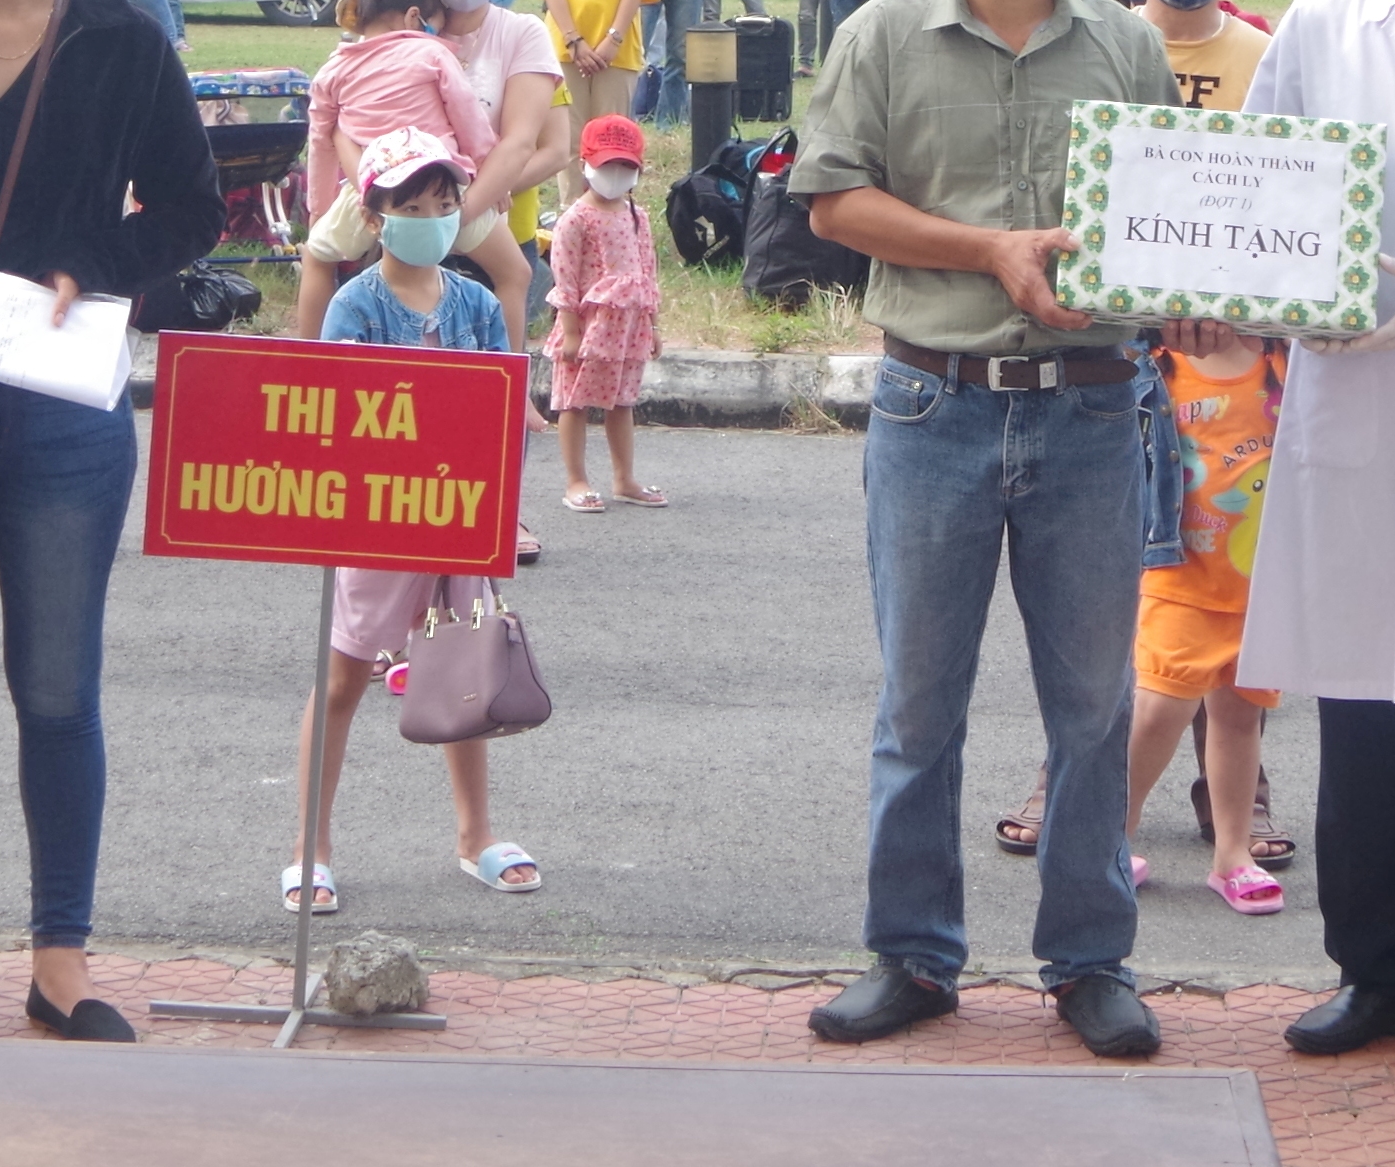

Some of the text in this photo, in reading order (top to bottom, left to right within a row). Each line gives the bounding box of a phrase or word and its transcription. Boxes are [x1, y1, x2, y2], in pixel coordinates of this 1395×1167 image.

[1169, 149, 1203, 164] CON
[1242, 174, 1264, 189] LY
[1241, 197, 1253, 211] 1)
[1124, 213, 1322, 259] KÍNH TẶNG
[261, 381, 417, 447] THỊ XÃ
[1171, 394, 1230, 424] appy
[179, 459, 486, 528] HƯƠNG THỦY
